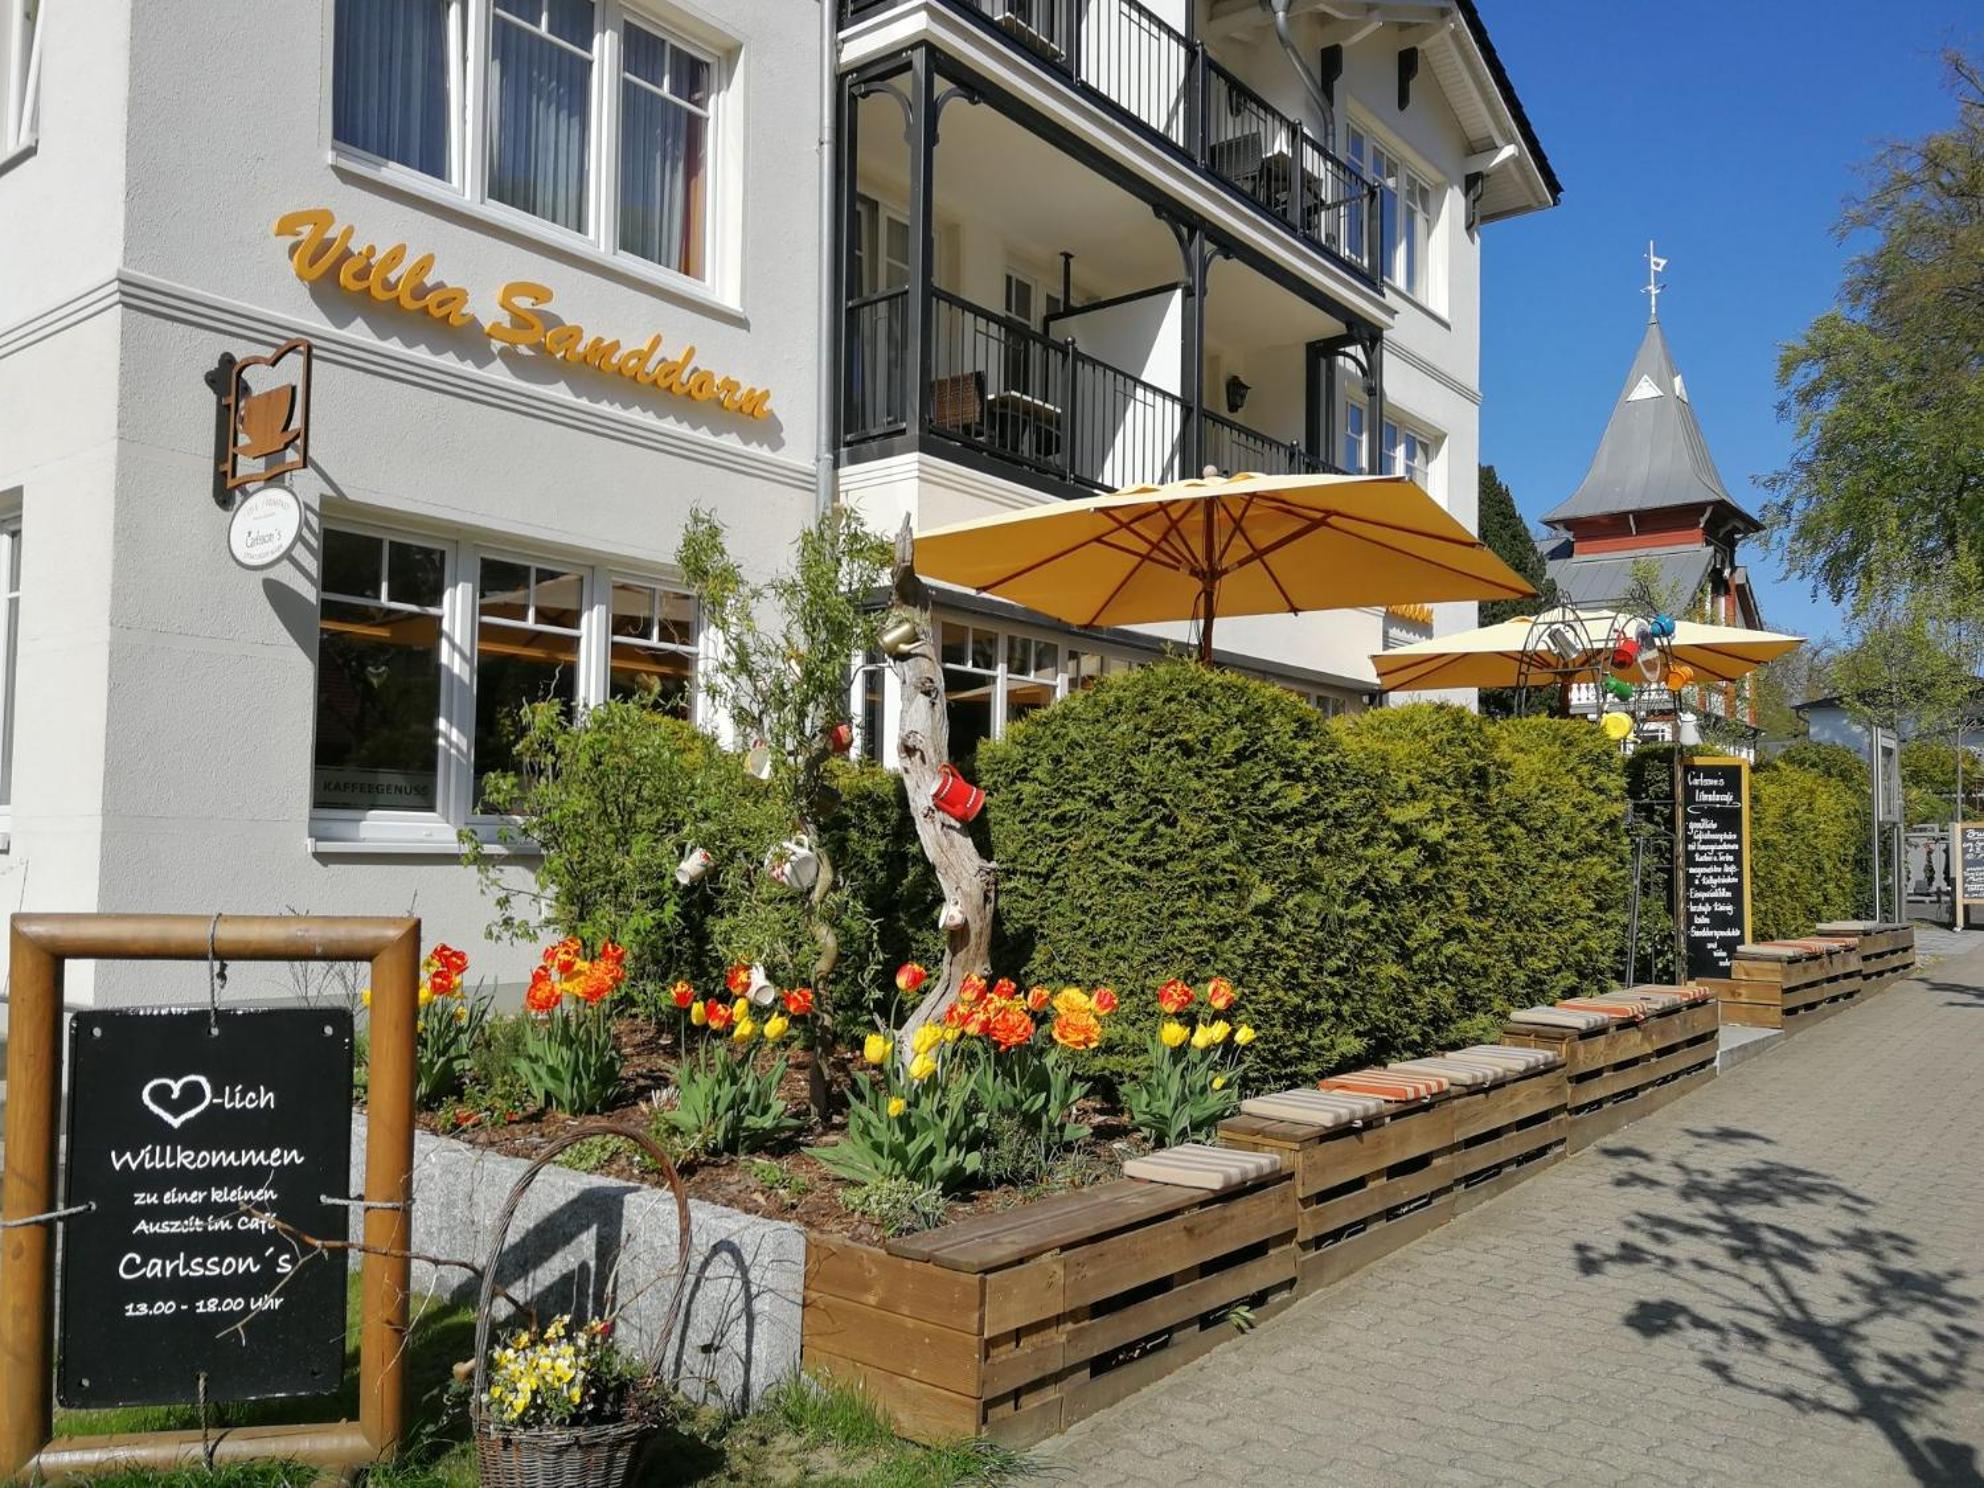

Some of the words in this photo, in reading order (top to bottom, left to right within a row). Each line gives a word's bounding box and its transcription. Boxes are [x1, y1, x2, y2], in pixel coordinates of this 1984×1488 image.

[273, 207, 477, 328] Villa
[485, 281, 772, 421] Sanddorn
[322, 780, 430, 797] KAFFEEGENUSS
[110, 1144, 304, 1171] Willkommen
[133, 1192, 159, 1205] zu
[163, 1187, 207, 1204] einer
[211, 1186, 278, 1203] kleinen
[132, 1215, 204, 1234] Auszeit
[207, 1214, 233, 1231] im
[124, 1302, 176, 1317] 13.00
[195, 1297, 245, 1313] 18.00
[250, 1294, 284, 1311] Uhr
